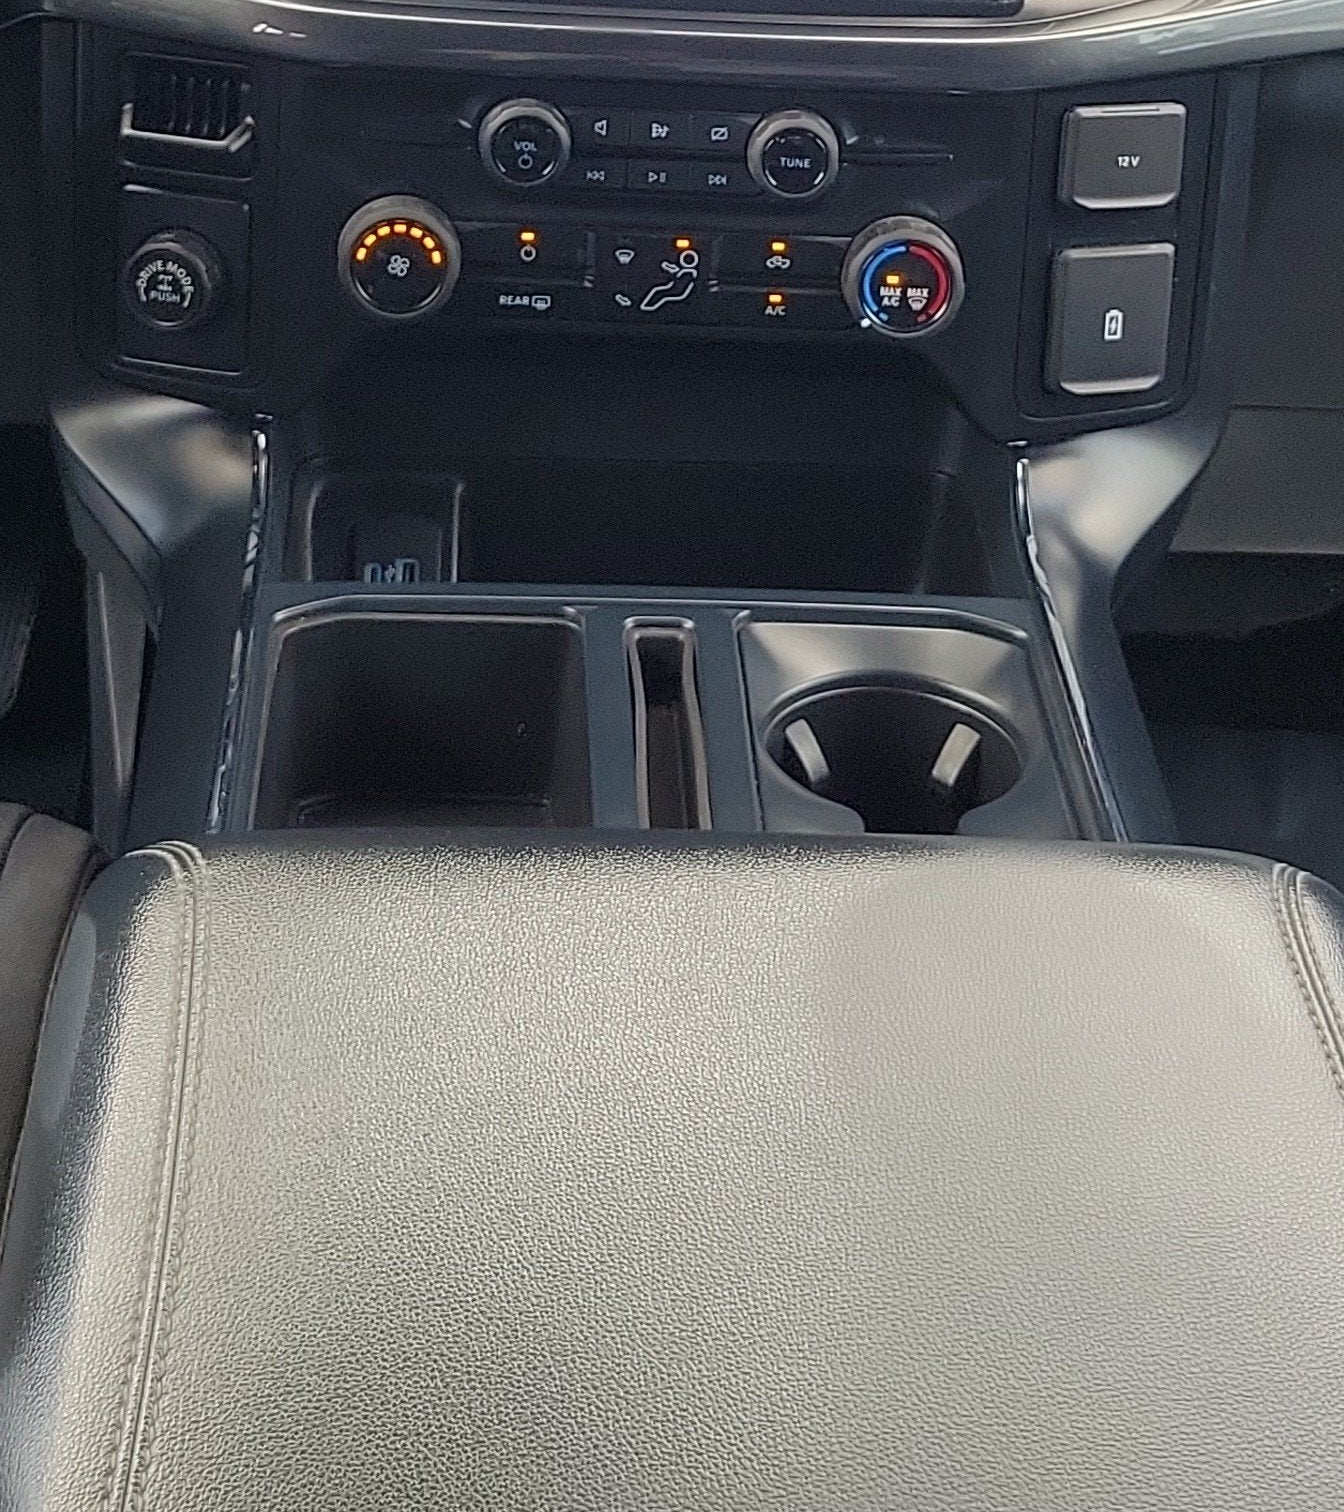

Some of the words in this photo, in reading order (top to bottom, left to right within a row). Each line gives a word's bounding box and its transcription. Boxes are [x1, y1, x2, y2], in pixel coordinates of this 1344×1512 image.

[514, 141, 537, 152] VOL
[779, 157, 811, 169] TUNE
[136, 260, 166, 288] DRIVE
[166, 261, 194, 293] MODE
[150, 290, 181, 303] PUSH
[880, 286, 902, 298] MAX
[907, 287, 929, 298] MAX
[499, 295, 530, 306] REAR
[765, 305, 786, 316] A/C
